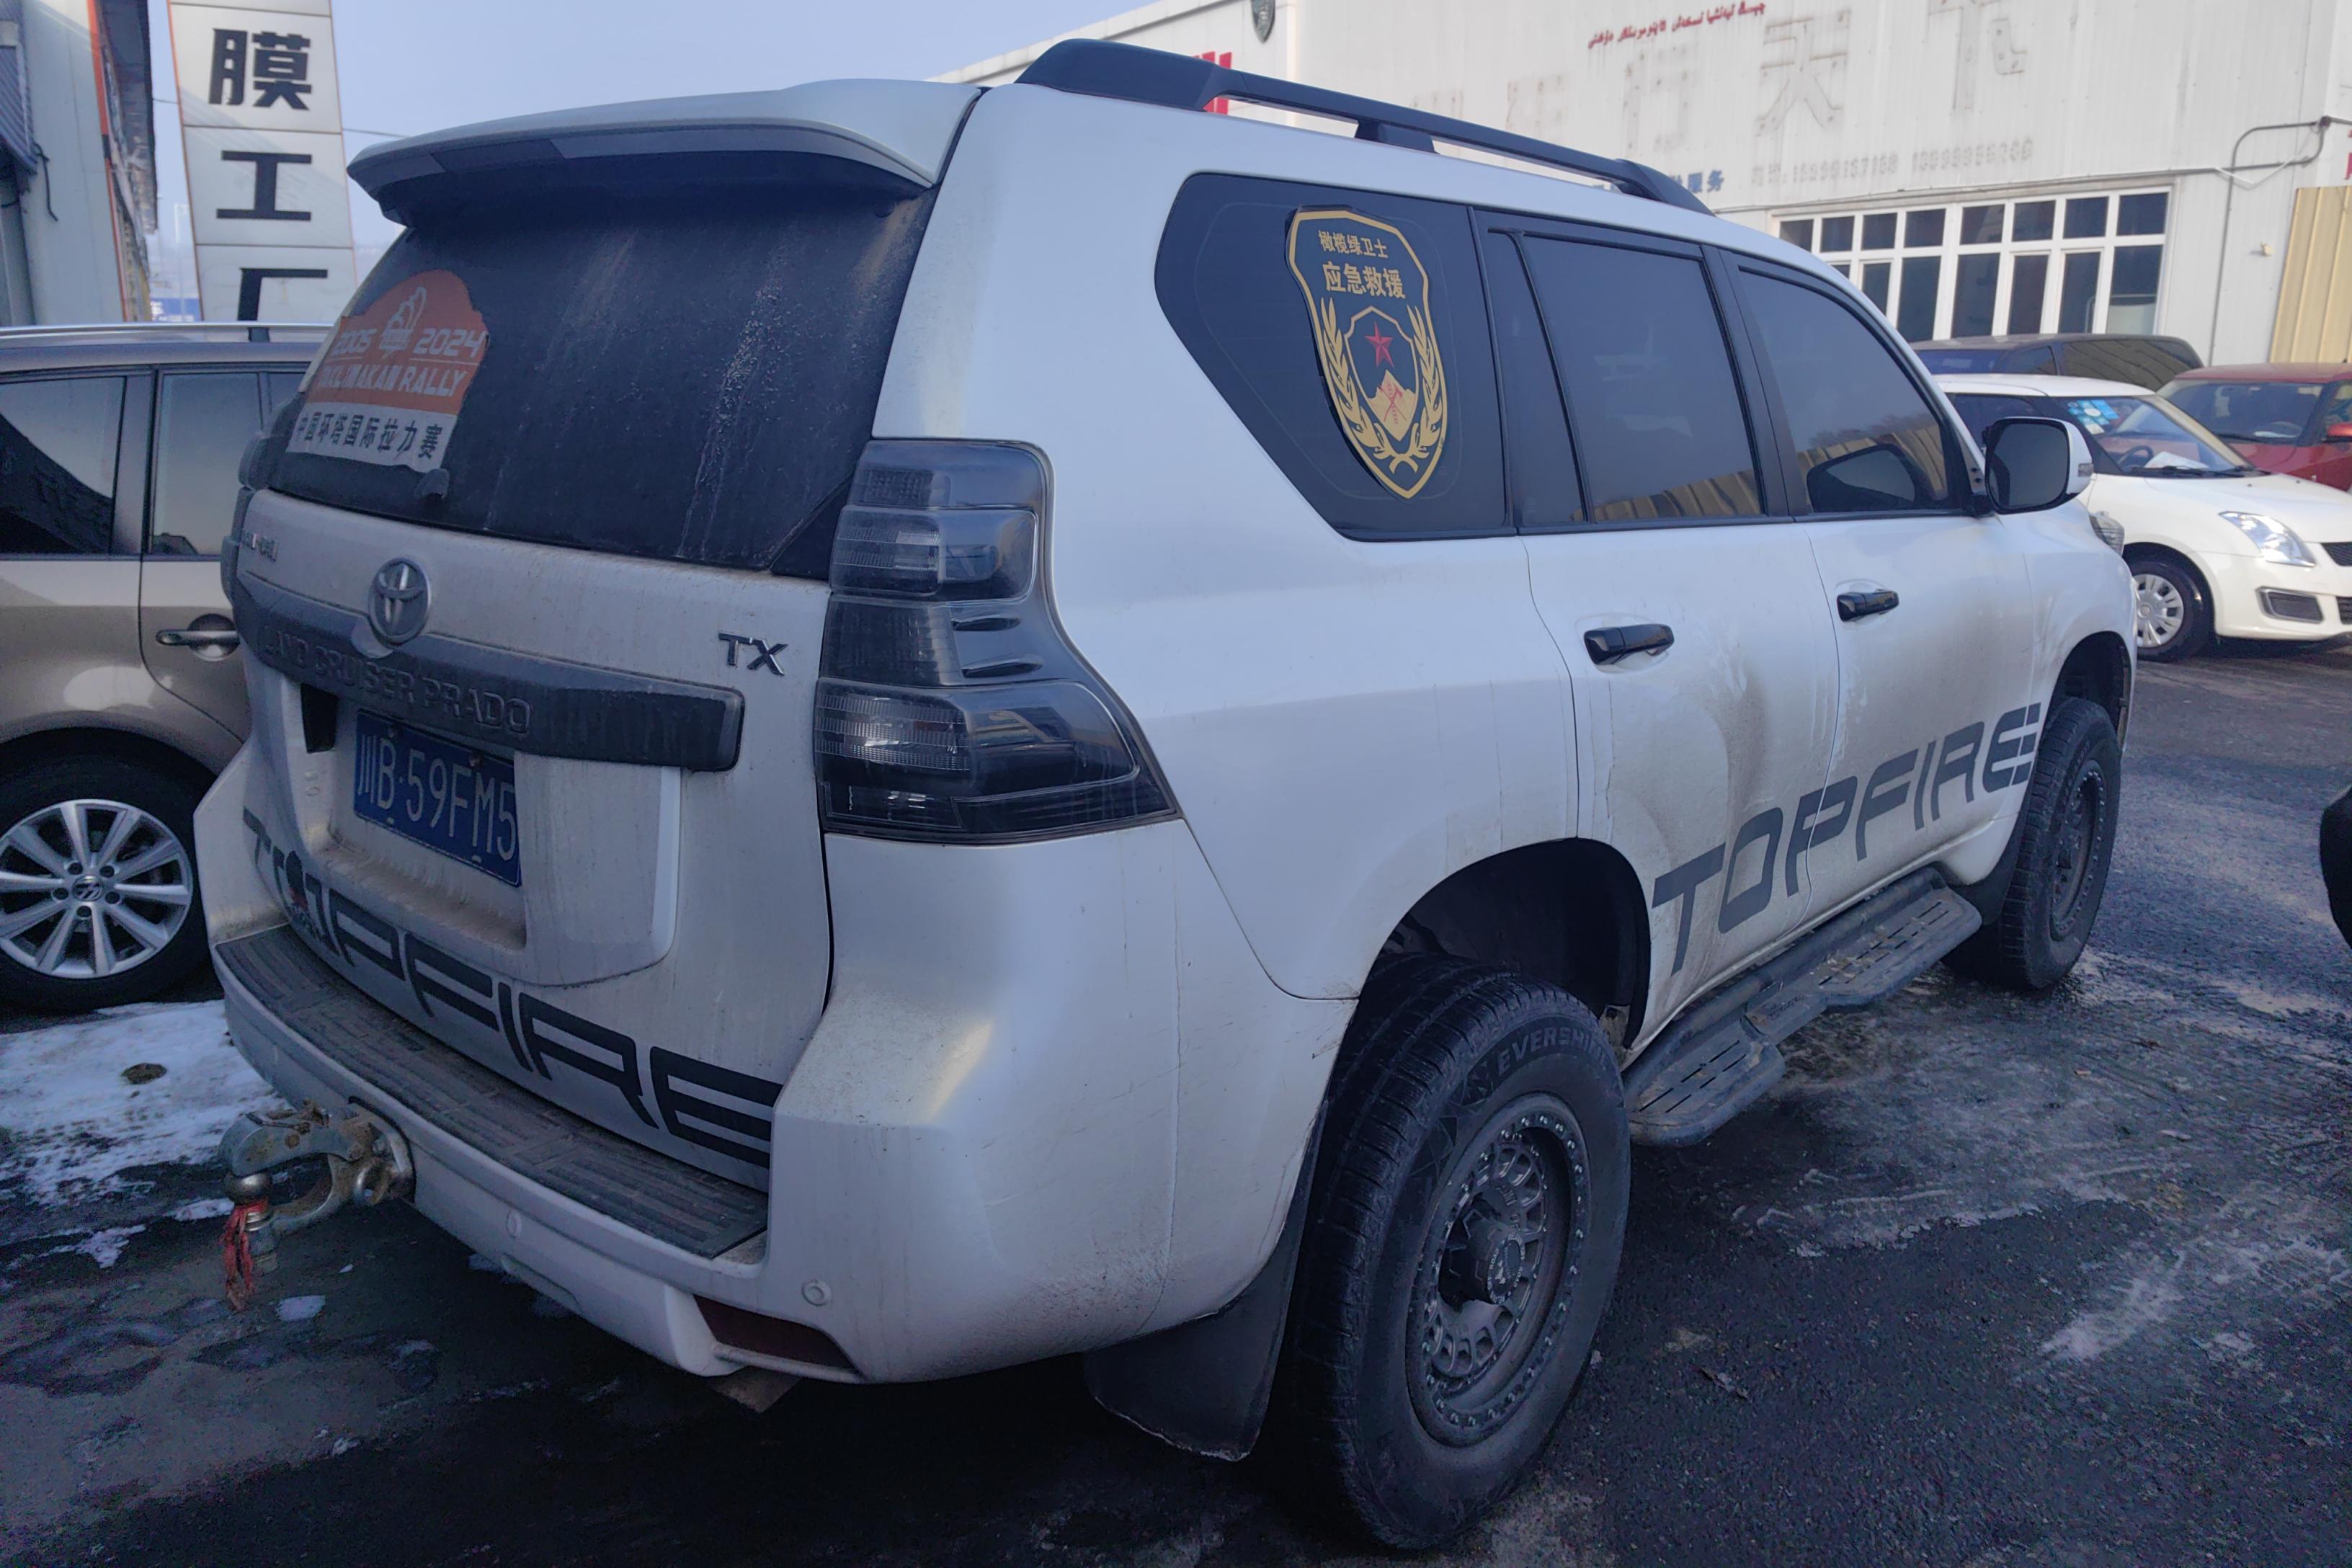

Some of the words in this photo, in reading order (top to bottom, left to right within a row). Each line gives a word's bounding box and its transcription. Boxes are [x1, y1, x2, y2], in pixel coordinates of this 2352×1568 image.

[1318, 230, 1389, 259] 橄榄绿卫士
[1322, 261, 1406, 299] 应急救援
[413, 328, 487, 359] 2024
[398, 365, 468, 398] RALLY
[718, 632, 790, 677] TX
[313, 643, 417, 705] CRUISER
[420, 675, 533, 736] PRADO
[1651, 702, 2041, 977] TOPFIRE
[243, 806, 785, 1170] TOPFIRE
